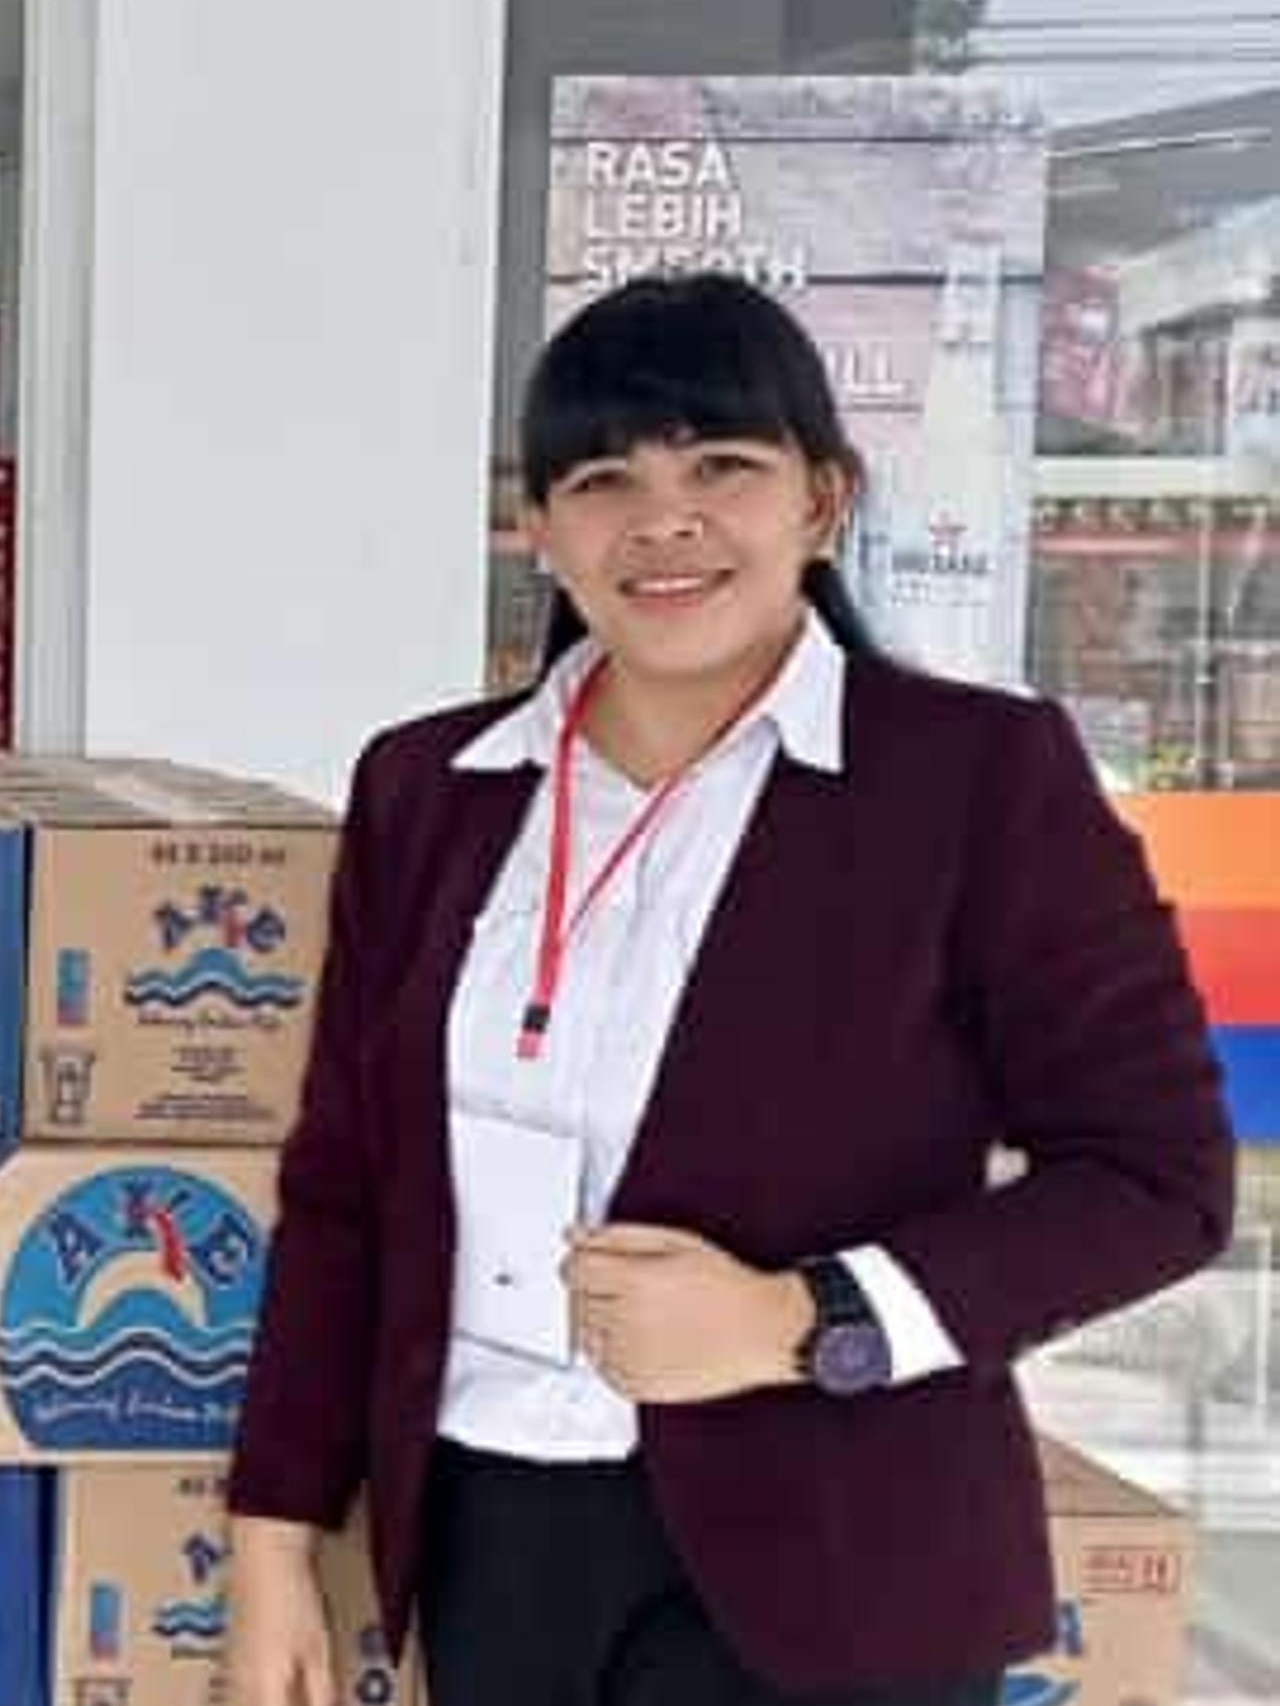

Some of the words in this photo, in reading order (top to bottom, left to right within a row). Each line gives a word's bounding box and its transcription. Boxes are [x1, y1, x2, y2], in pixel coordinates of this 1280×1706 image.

[588, 142, 728, 187] RASA
[587, 193, 742, 238] LEBIH
[47, 1178, 256, 1284] AKE
